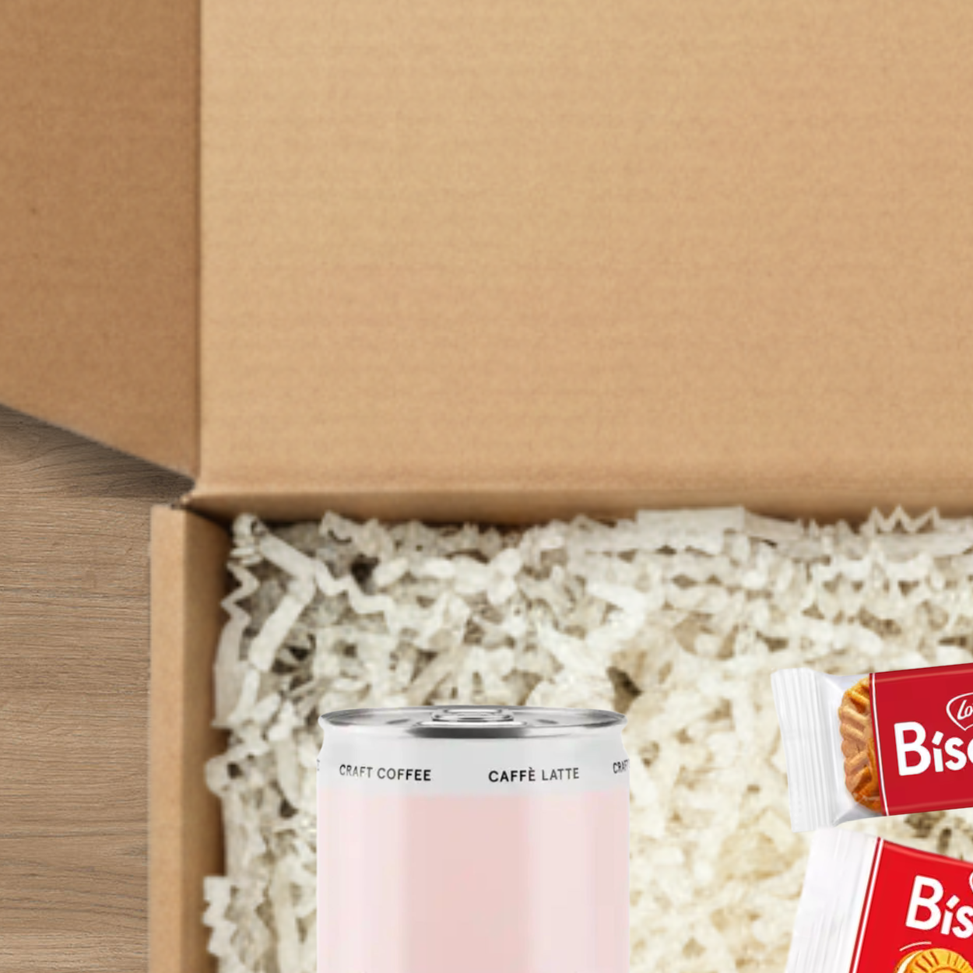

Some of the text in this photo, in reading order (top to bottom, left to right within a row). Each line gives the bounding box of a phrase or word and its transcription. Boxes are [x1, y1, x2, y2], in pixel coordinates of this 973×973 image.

[339, 764, 431, 781] CRAFT COFFEE
[489, 767, 579, 782] CAFFÈ LATTE
